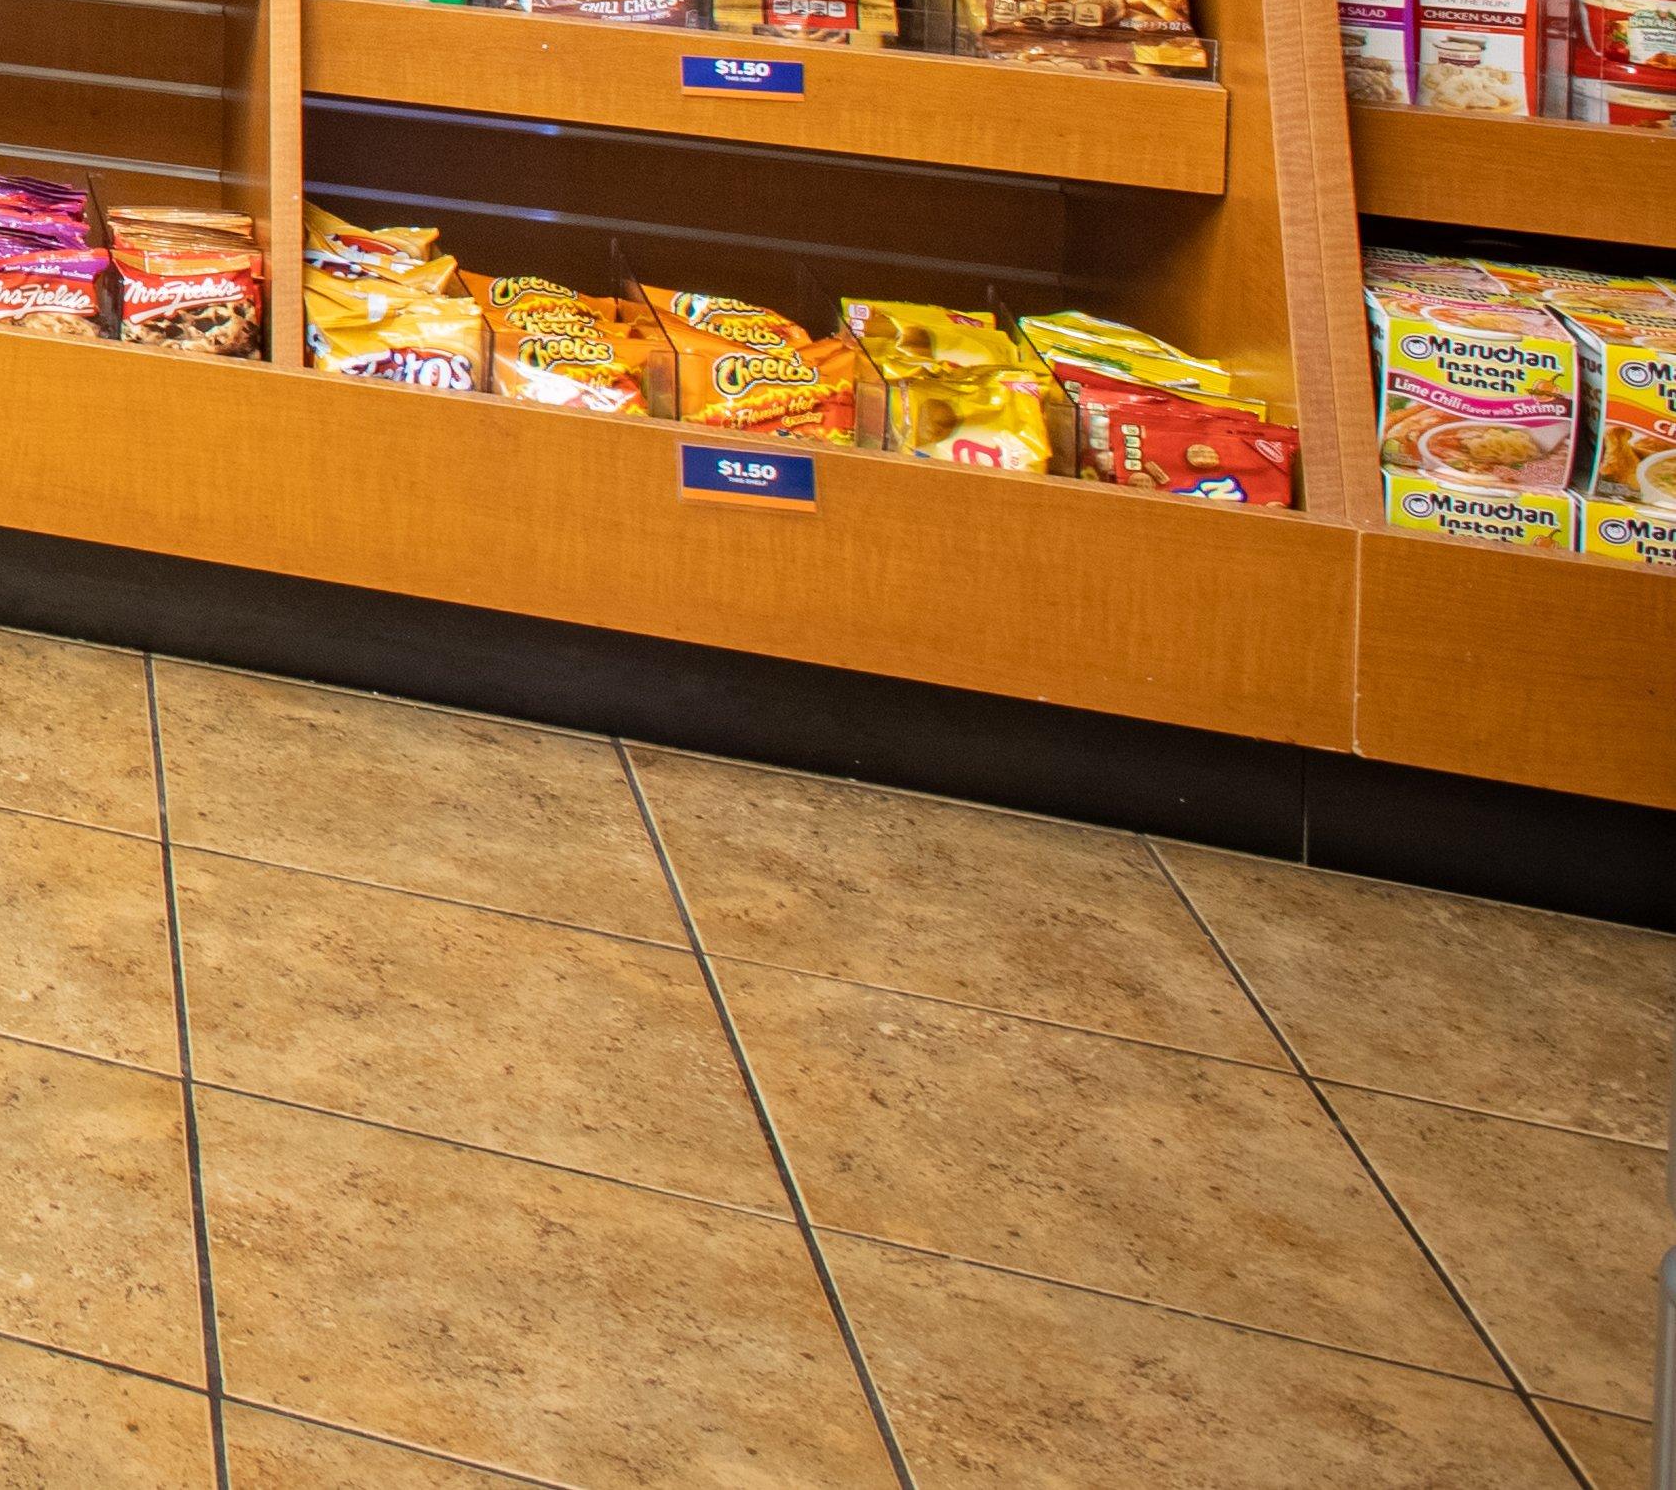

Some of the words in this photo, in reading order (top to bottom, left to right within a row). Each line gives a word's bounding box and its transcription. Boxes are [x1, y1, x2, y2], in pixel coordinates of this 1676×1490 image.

[714, 60, 771, 78] $1.50
[1428, 335, 1557, 371] Maruchan
[712, 352, 818, 396] Cheetos
[1437, 357, 1526, 382] Instant
[1447, 372, 1515, 393] Lunch
[717, 461, 777, 480] $1.50
